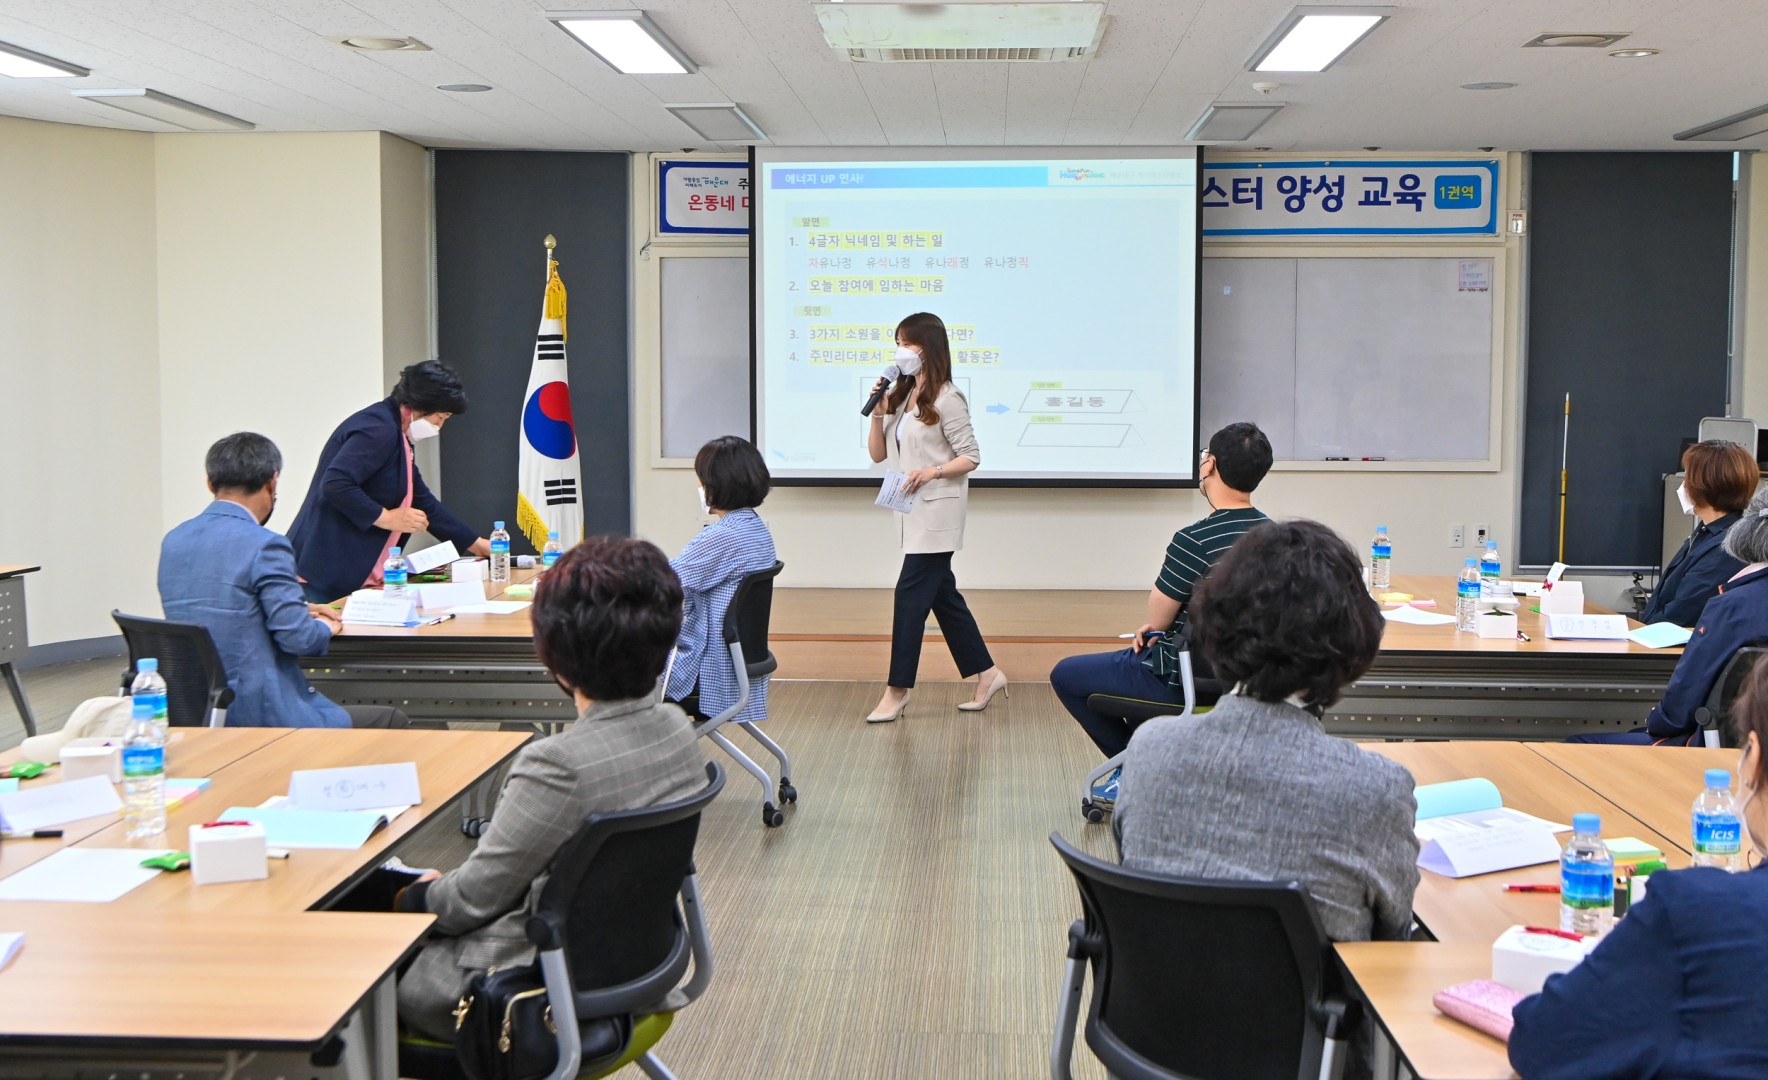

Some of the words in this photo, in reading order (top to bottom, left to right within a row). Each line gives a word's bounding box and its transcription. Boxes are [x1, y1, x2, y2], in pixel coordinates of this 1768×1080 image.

[785, 172, 817, 184] 에너지
[820, 173, 836, 184] UP
[839, 172, 864, 184] 인사!
[1276, 174, 1345, 213] 양성
[1357, 174, 1426, 212] 교육
[1439, 185, 1475, 200] 1권역
[688, 194, 735, 212] 온동네
[802, 216, 821, 228] 앞면
[789, 236, 799, 247] 1.
[808, 234, 840, 248] 4글자
[846, 234, 881, 248] 닉네임
[886, 234, 897, 247] 및
[902, 234, 926, 247] 하는
[932, 234, 943, 247] 일
[808, 256, 852, 269] 자유나정
[866, 256, 911, 269] 유식나정
[925, 256, 969, 269] 유나래정
[984, 256, 1029, 269] 유나정직
[789, 281, 799, 291] 2.
[809, 279, 834, 292] 오늘
[838, 279, 875, 292] 참여에
[879, 279, 915, 292] 임하는
[920, 279, 944, 292] 마음
[803, 306, 822, 317] 뒷면
[789, 330, 799, 340] 3.
[809, 327, 840, 341] 3가지
[845, 327, 881, 341] 소원을
[789, 352, 799, 362] 4.
[809, 350, 882, 363] 주민리더로서
[956, 349, 999, 363] 활동은?
[1045, 396, 1106, 408] 홍길동
[1711, 830, 1735, 840] ICIS
